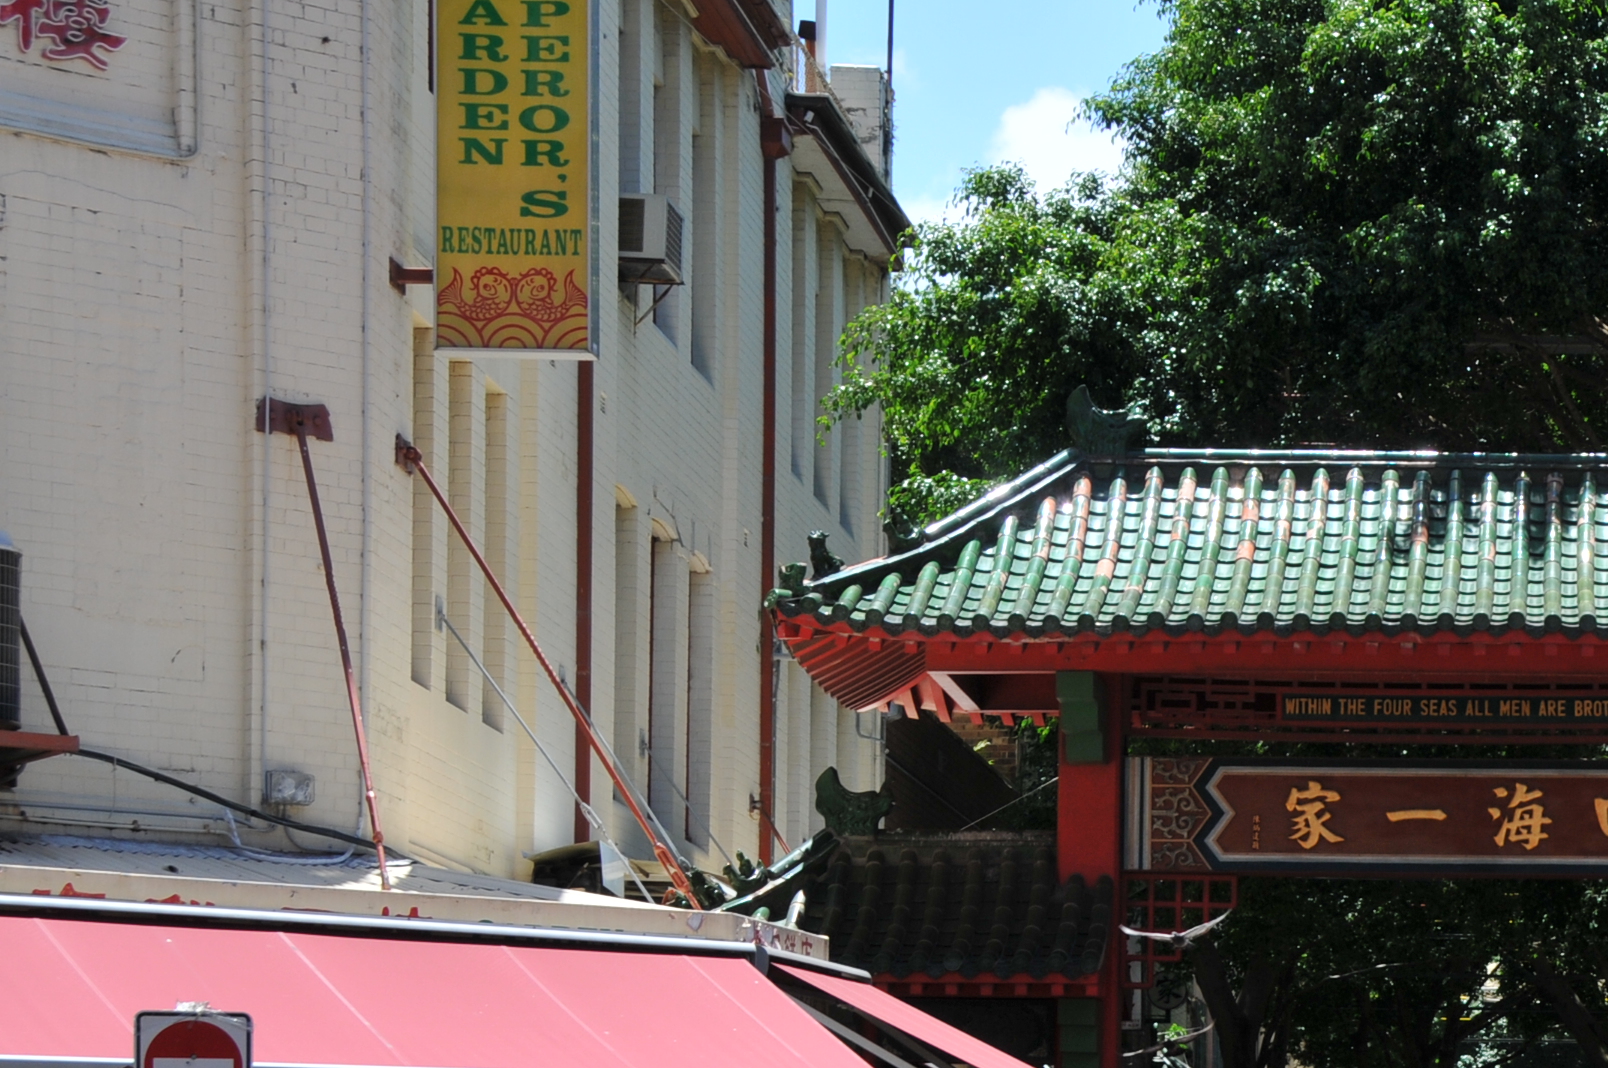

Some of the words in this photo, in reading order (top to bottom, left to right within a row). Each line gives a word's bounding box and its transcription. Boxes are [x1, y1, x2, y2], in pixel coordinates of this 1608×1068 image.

[441, 226, 582, 256] RESTAURANT
[1285, 698, 1331, 716] WITHIN
[1339, 698, 1366, 716] THE
[1374, 698, 1411, 716] FOUR
[1420, 699, 1457, 717] SEAS
[1465, 699, 1493, 717] ALL
[1500, 699, 1530, 717] MEN
[1538, 699, 1566, 717] ARE
